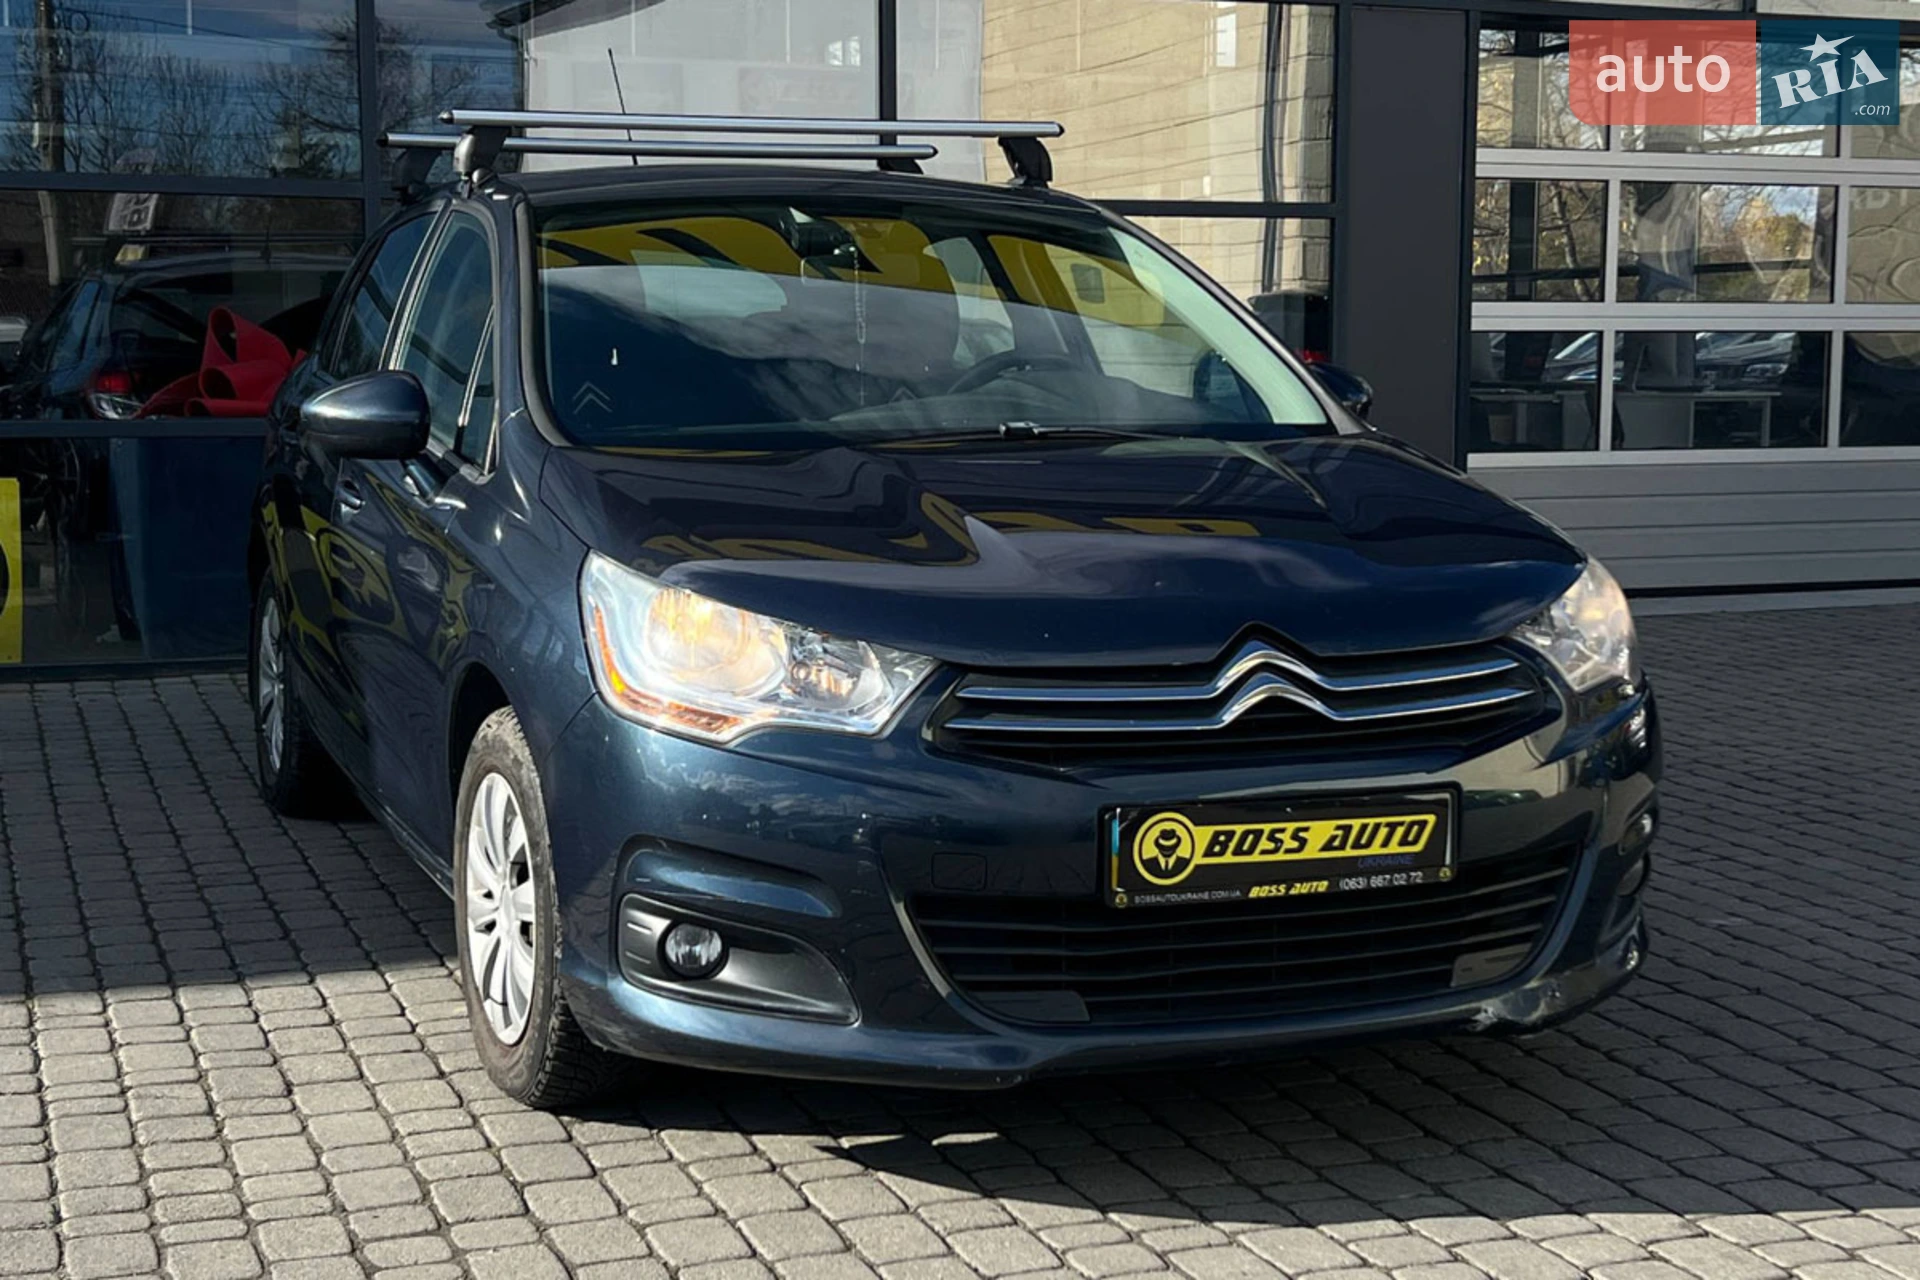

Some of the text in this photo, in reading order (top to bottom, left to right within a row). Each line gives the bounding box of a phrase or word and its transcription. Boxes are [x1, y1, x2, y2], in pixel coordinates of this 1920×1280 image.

[1201, 819, 1430, 858] BOSS AUTO
[1357, 854, 1416, 868] UKRAINE
[1248, 880, 1330, 899] BOSS AUTO
[1339, 876, 1368, 891] (063)
[1392, 872, 1407, 886] 02
[1409, 871, 1424, 883] 72
